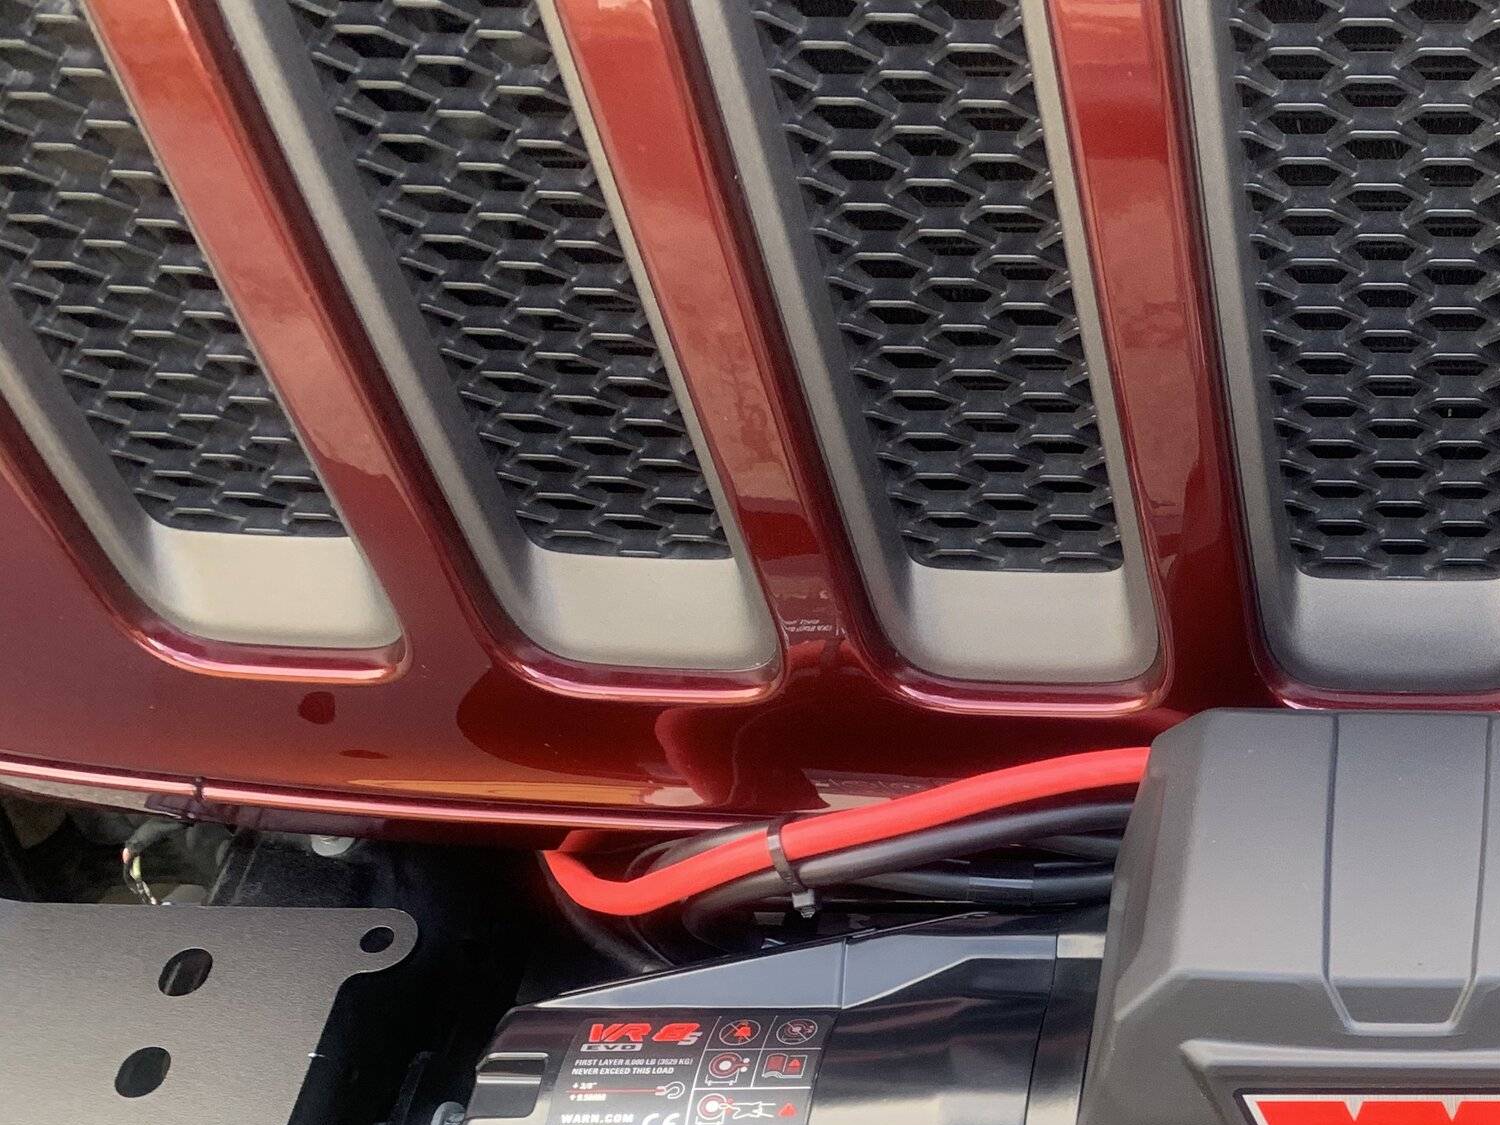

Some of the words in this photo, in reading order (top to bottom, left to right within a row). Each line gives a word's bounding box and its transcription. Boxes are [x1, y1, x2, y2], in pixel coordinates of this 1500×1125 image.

[588, 1022, 652, 1042] VR
[574, 1058, 598, 1066] FIRST
[599, 1058, 624, 1066] LAYER
[678, 1057, 693, 1066] KG)
[571, 1067, 598, 1075] NEVER
[599, 1067, 631, 1075] EXCEED
[632, 1067, 651, 1075] THIS
[652, 1067, 674, 1075] LOAD
[561, 1113, 634, 1124] WARN.COM
